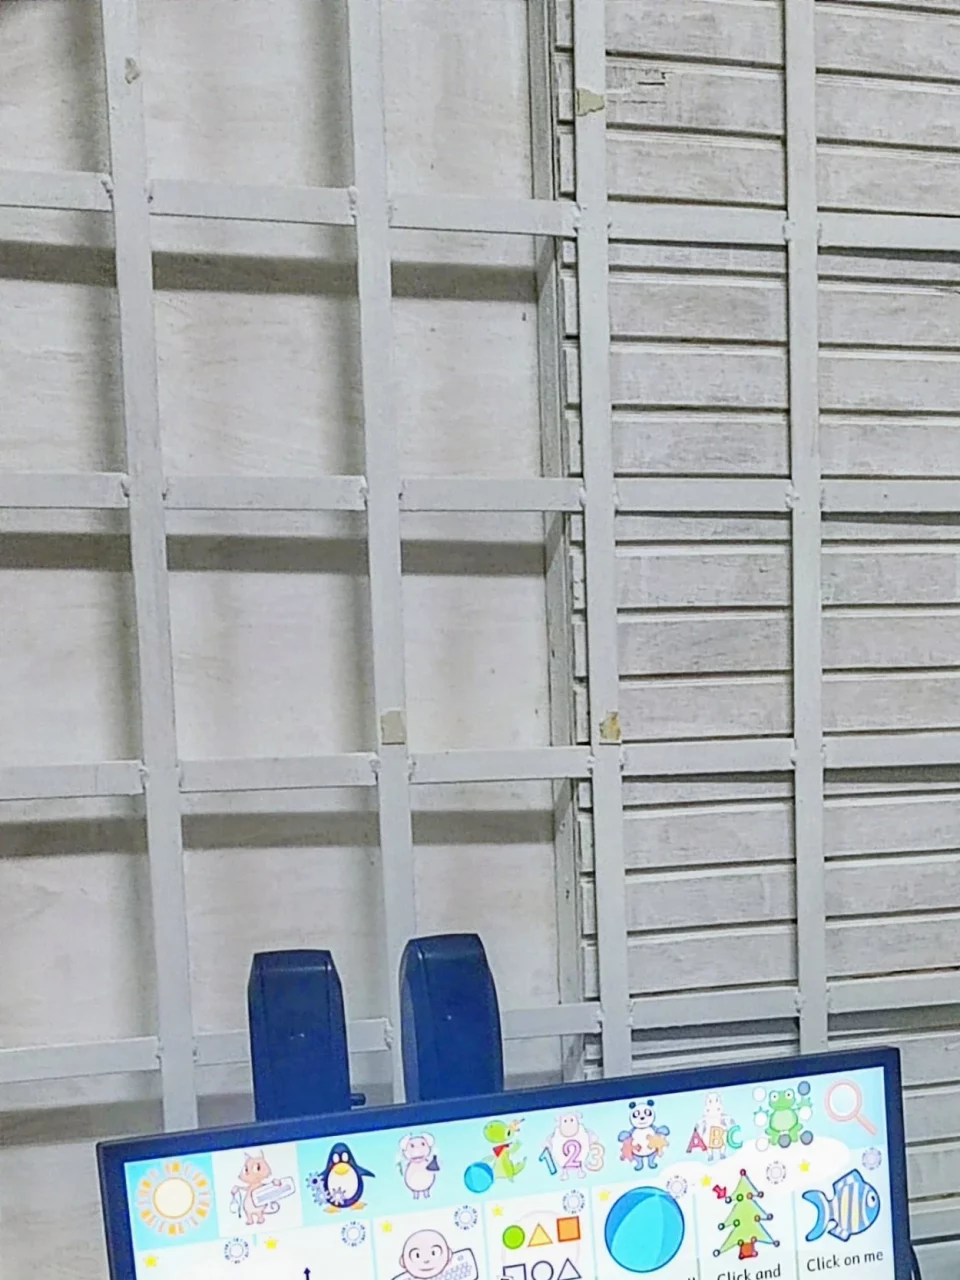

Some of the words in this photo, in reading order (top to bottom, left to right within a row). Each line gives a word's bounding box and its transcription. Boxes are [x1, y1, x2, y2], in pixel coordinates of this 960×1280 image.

[755, 1263, 782, 1280] and
[806, 1253, 840, 1273] Click
[843, 1254, 860, 1268] on
[863, 1250, 884, 1264] me
